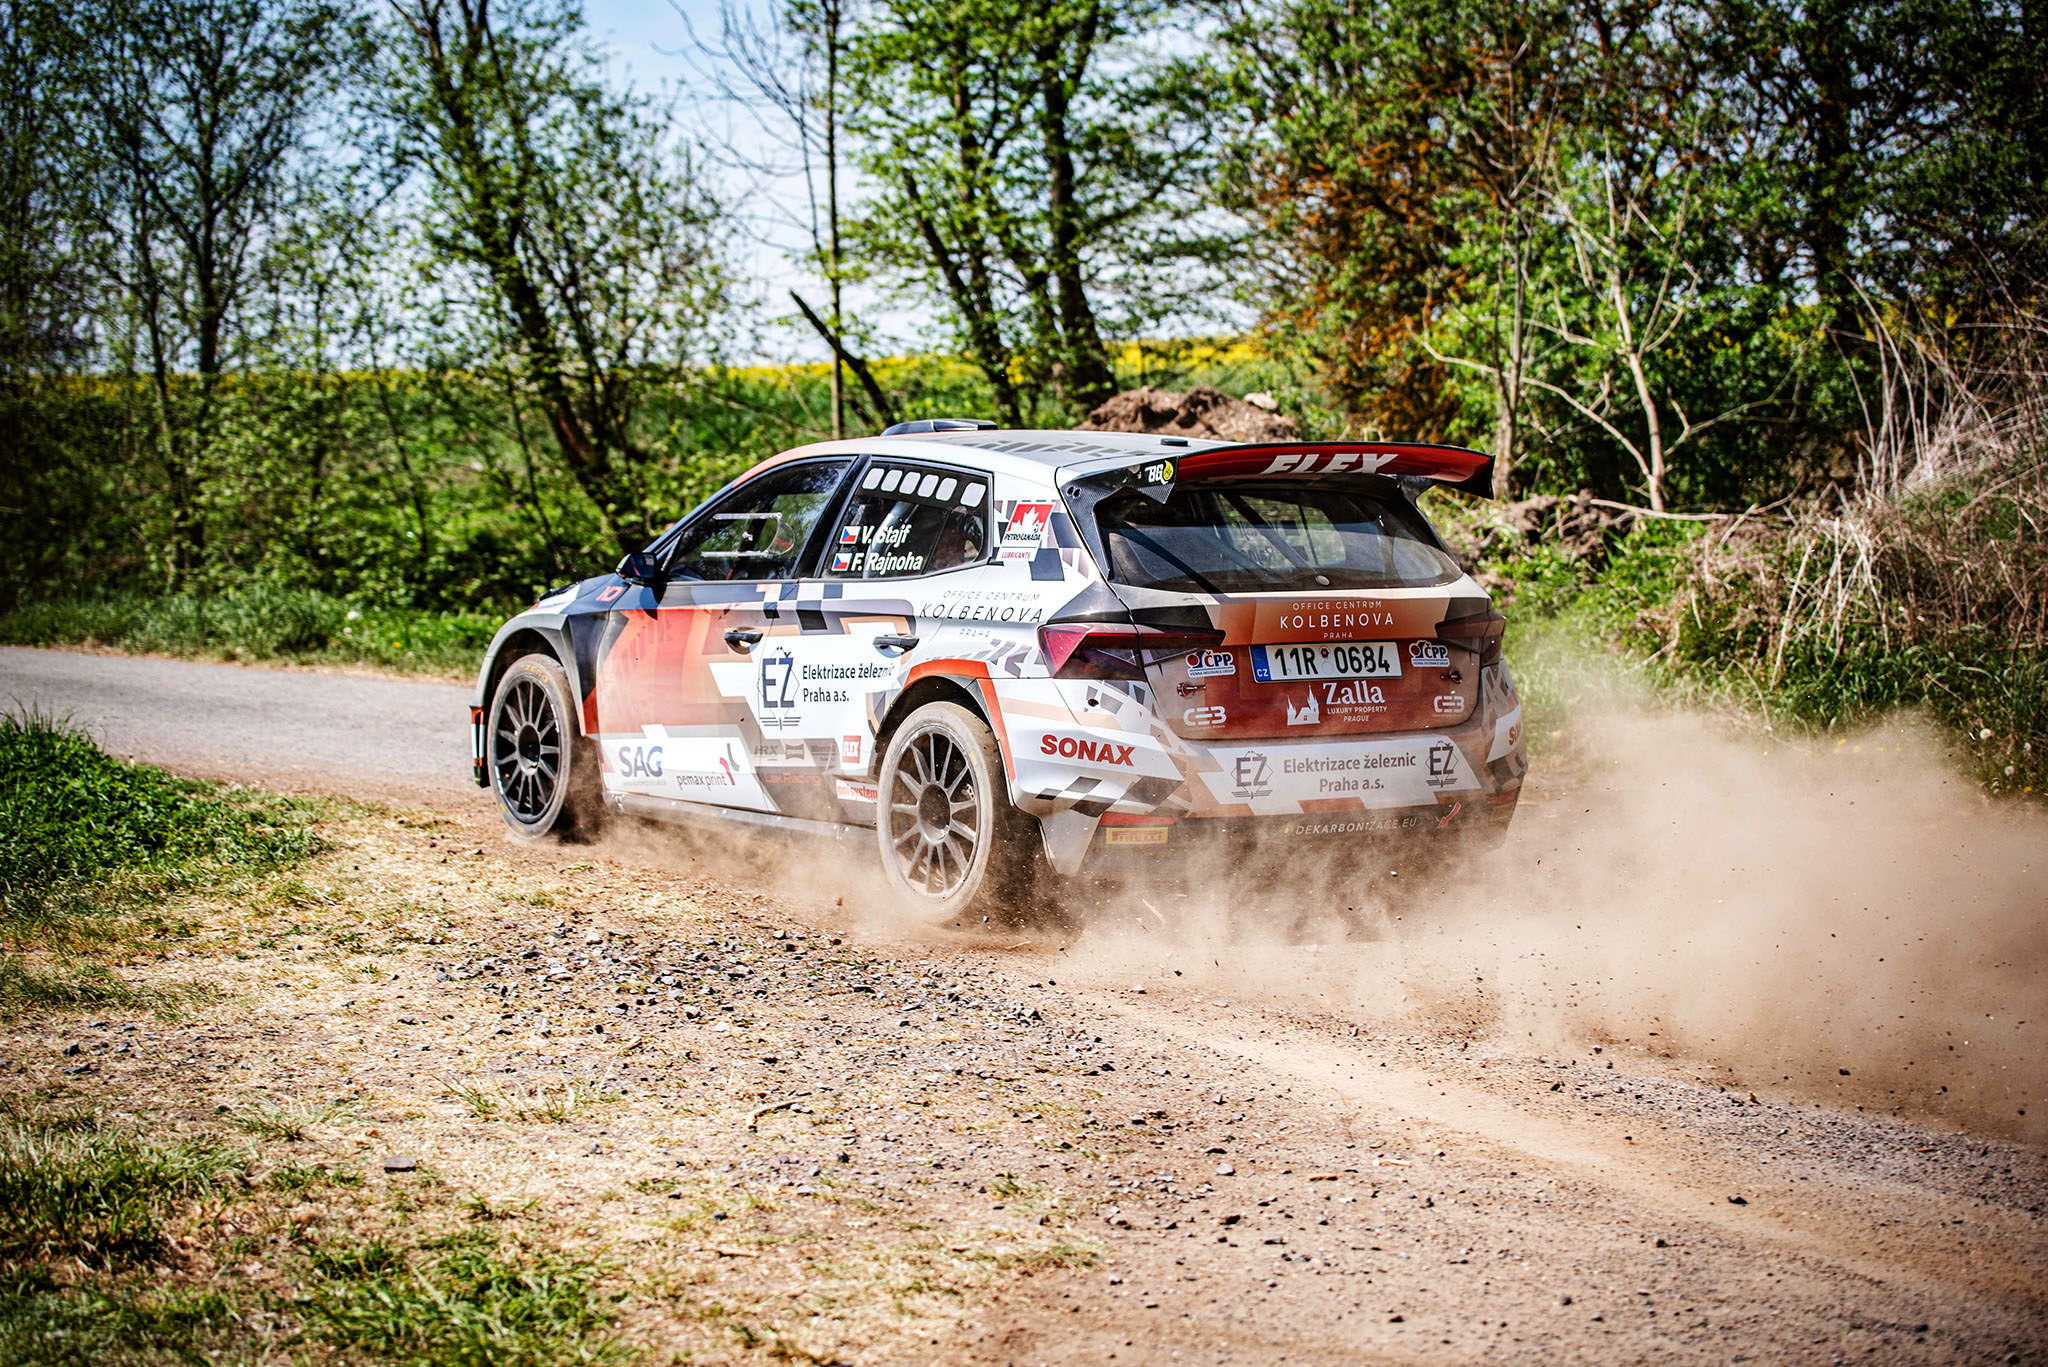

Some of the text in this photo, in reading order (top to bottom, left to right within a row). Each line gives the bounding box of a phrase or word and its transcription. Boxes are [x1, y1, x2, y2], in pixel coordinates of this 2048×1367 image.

[1259, 453, 1400, 475] FLEX
[861, 524, 912, 548] V. Stajf
[850, 551, 924, 576] F. Rajnoha
[1001, 551, 1032, 559] LUBRICANTS
[942, 590, 1040, 602] OFFICE CENTRUM
[919, 603, 1043, 623] KOLBENOVA
[1291, 600, 1382, 611] OFFICE CENTRUM
[1280, 612, 1394, 629] KOLBENOVA
[1323, 631, 1353, 640] PRAHA
[1204, 651, 1232, 668] ČPP
[1424, 643, 1447, 659] ČPP
[1274, 645, 1391, 676] 11R 0684
[802, 664, 856, 680] Elektrizace
[1256, 668, 1269, 678] CZ
[803, 687, 850, 702] Praha a.s.
[1322, 680, 1386, 705] Zalla
[1343, 715, 1370, 723] PRAGUE
[1040, 734, 1136, 767] SONAX
[619, 746, 663, 778] SAG
[1283, 752, 1416, 774] Elektrizace železnic
[676, 773, 728, 791] pemax print
[1319, 777, 1385, 793] Praha a.s.
[1295, 818, 1417, 835] DEKARBONIZACE.EU
